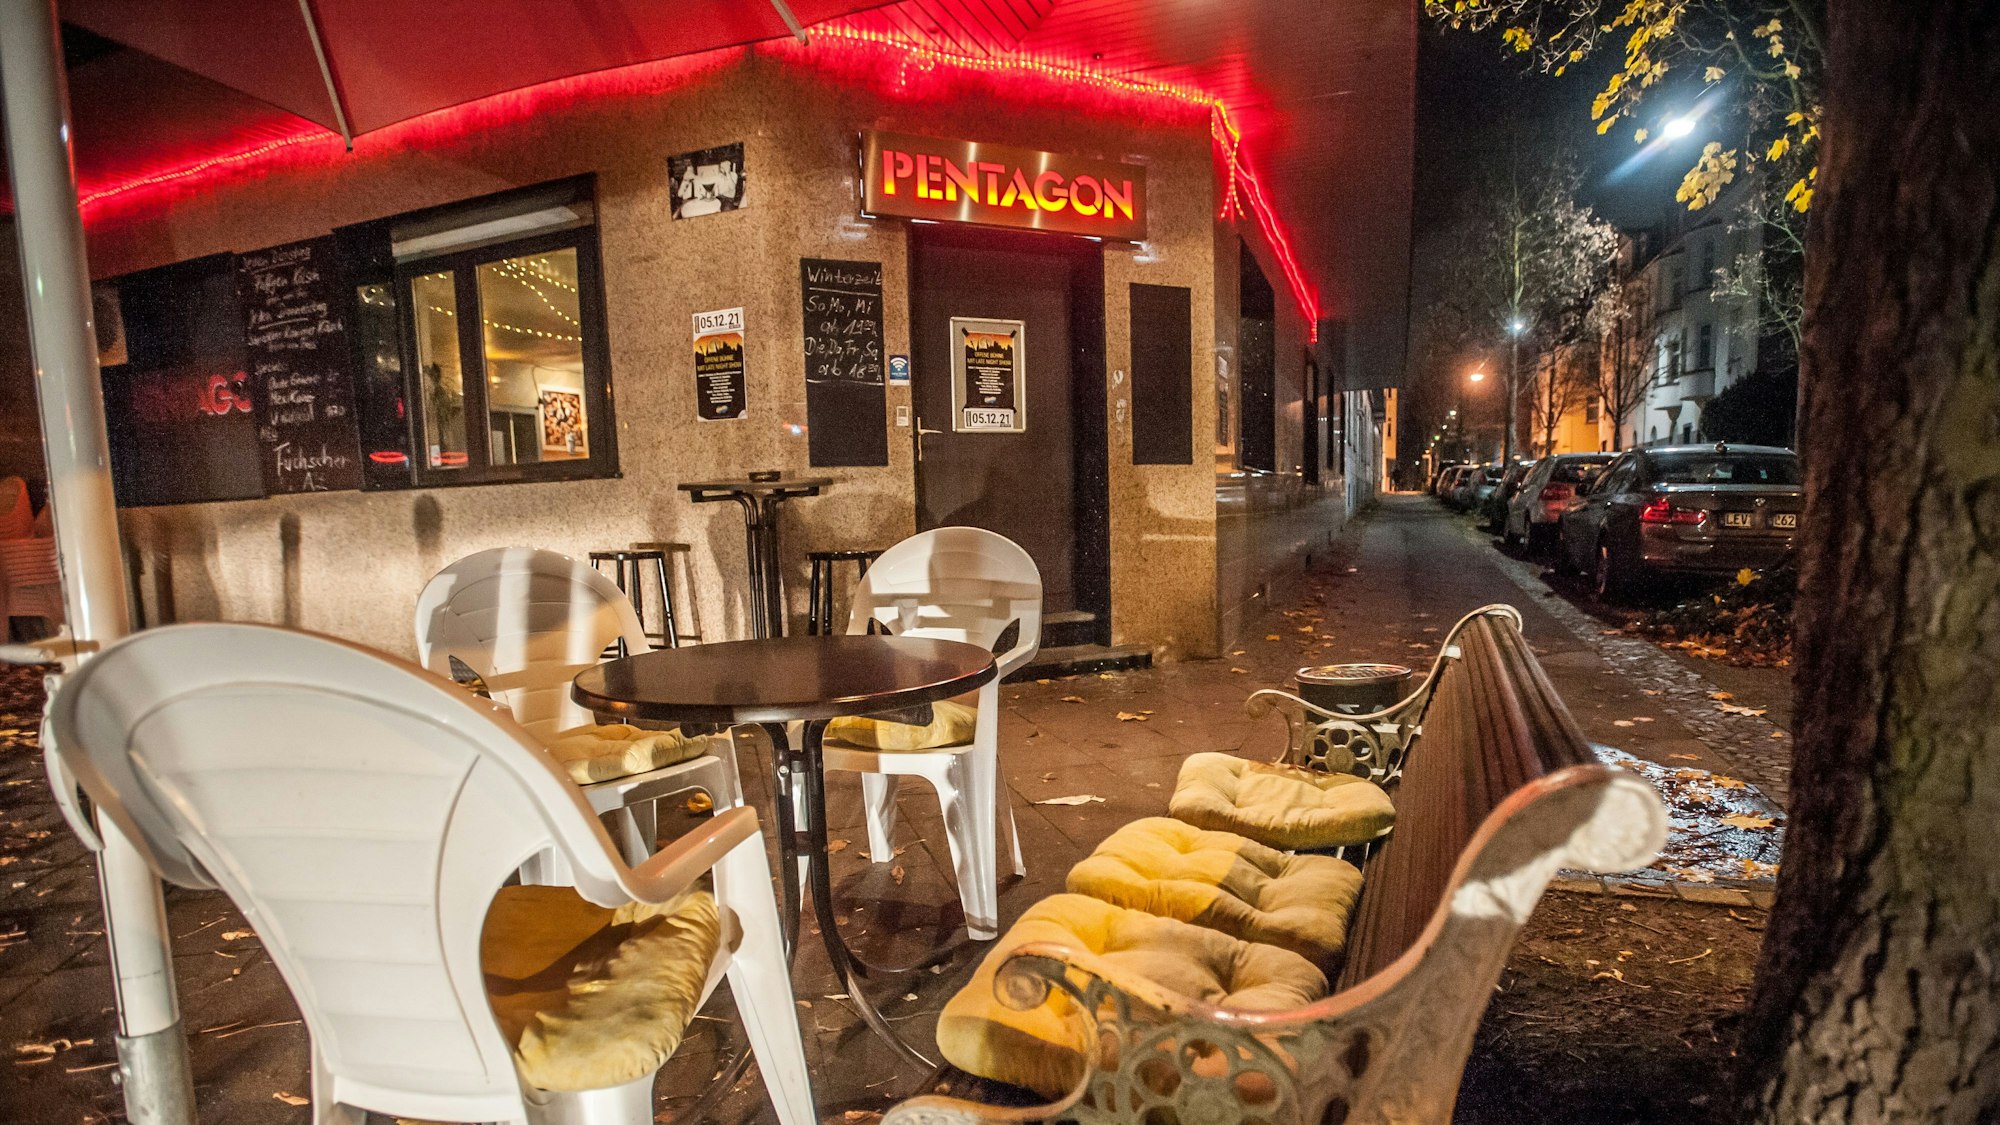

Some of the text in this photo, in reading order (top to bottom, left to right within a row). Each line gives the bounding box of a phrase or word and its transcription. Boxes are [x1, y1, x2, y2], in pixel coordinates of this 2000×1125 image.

[883, 150, 1134, 221] PENTAGON
[807, 266, 882, 286] Winterzeit
[700, 312, 740, 329] 05.12.21
[818, 359, 842, 376] ab
[972, 412, 1010, 424] 05.12.21
